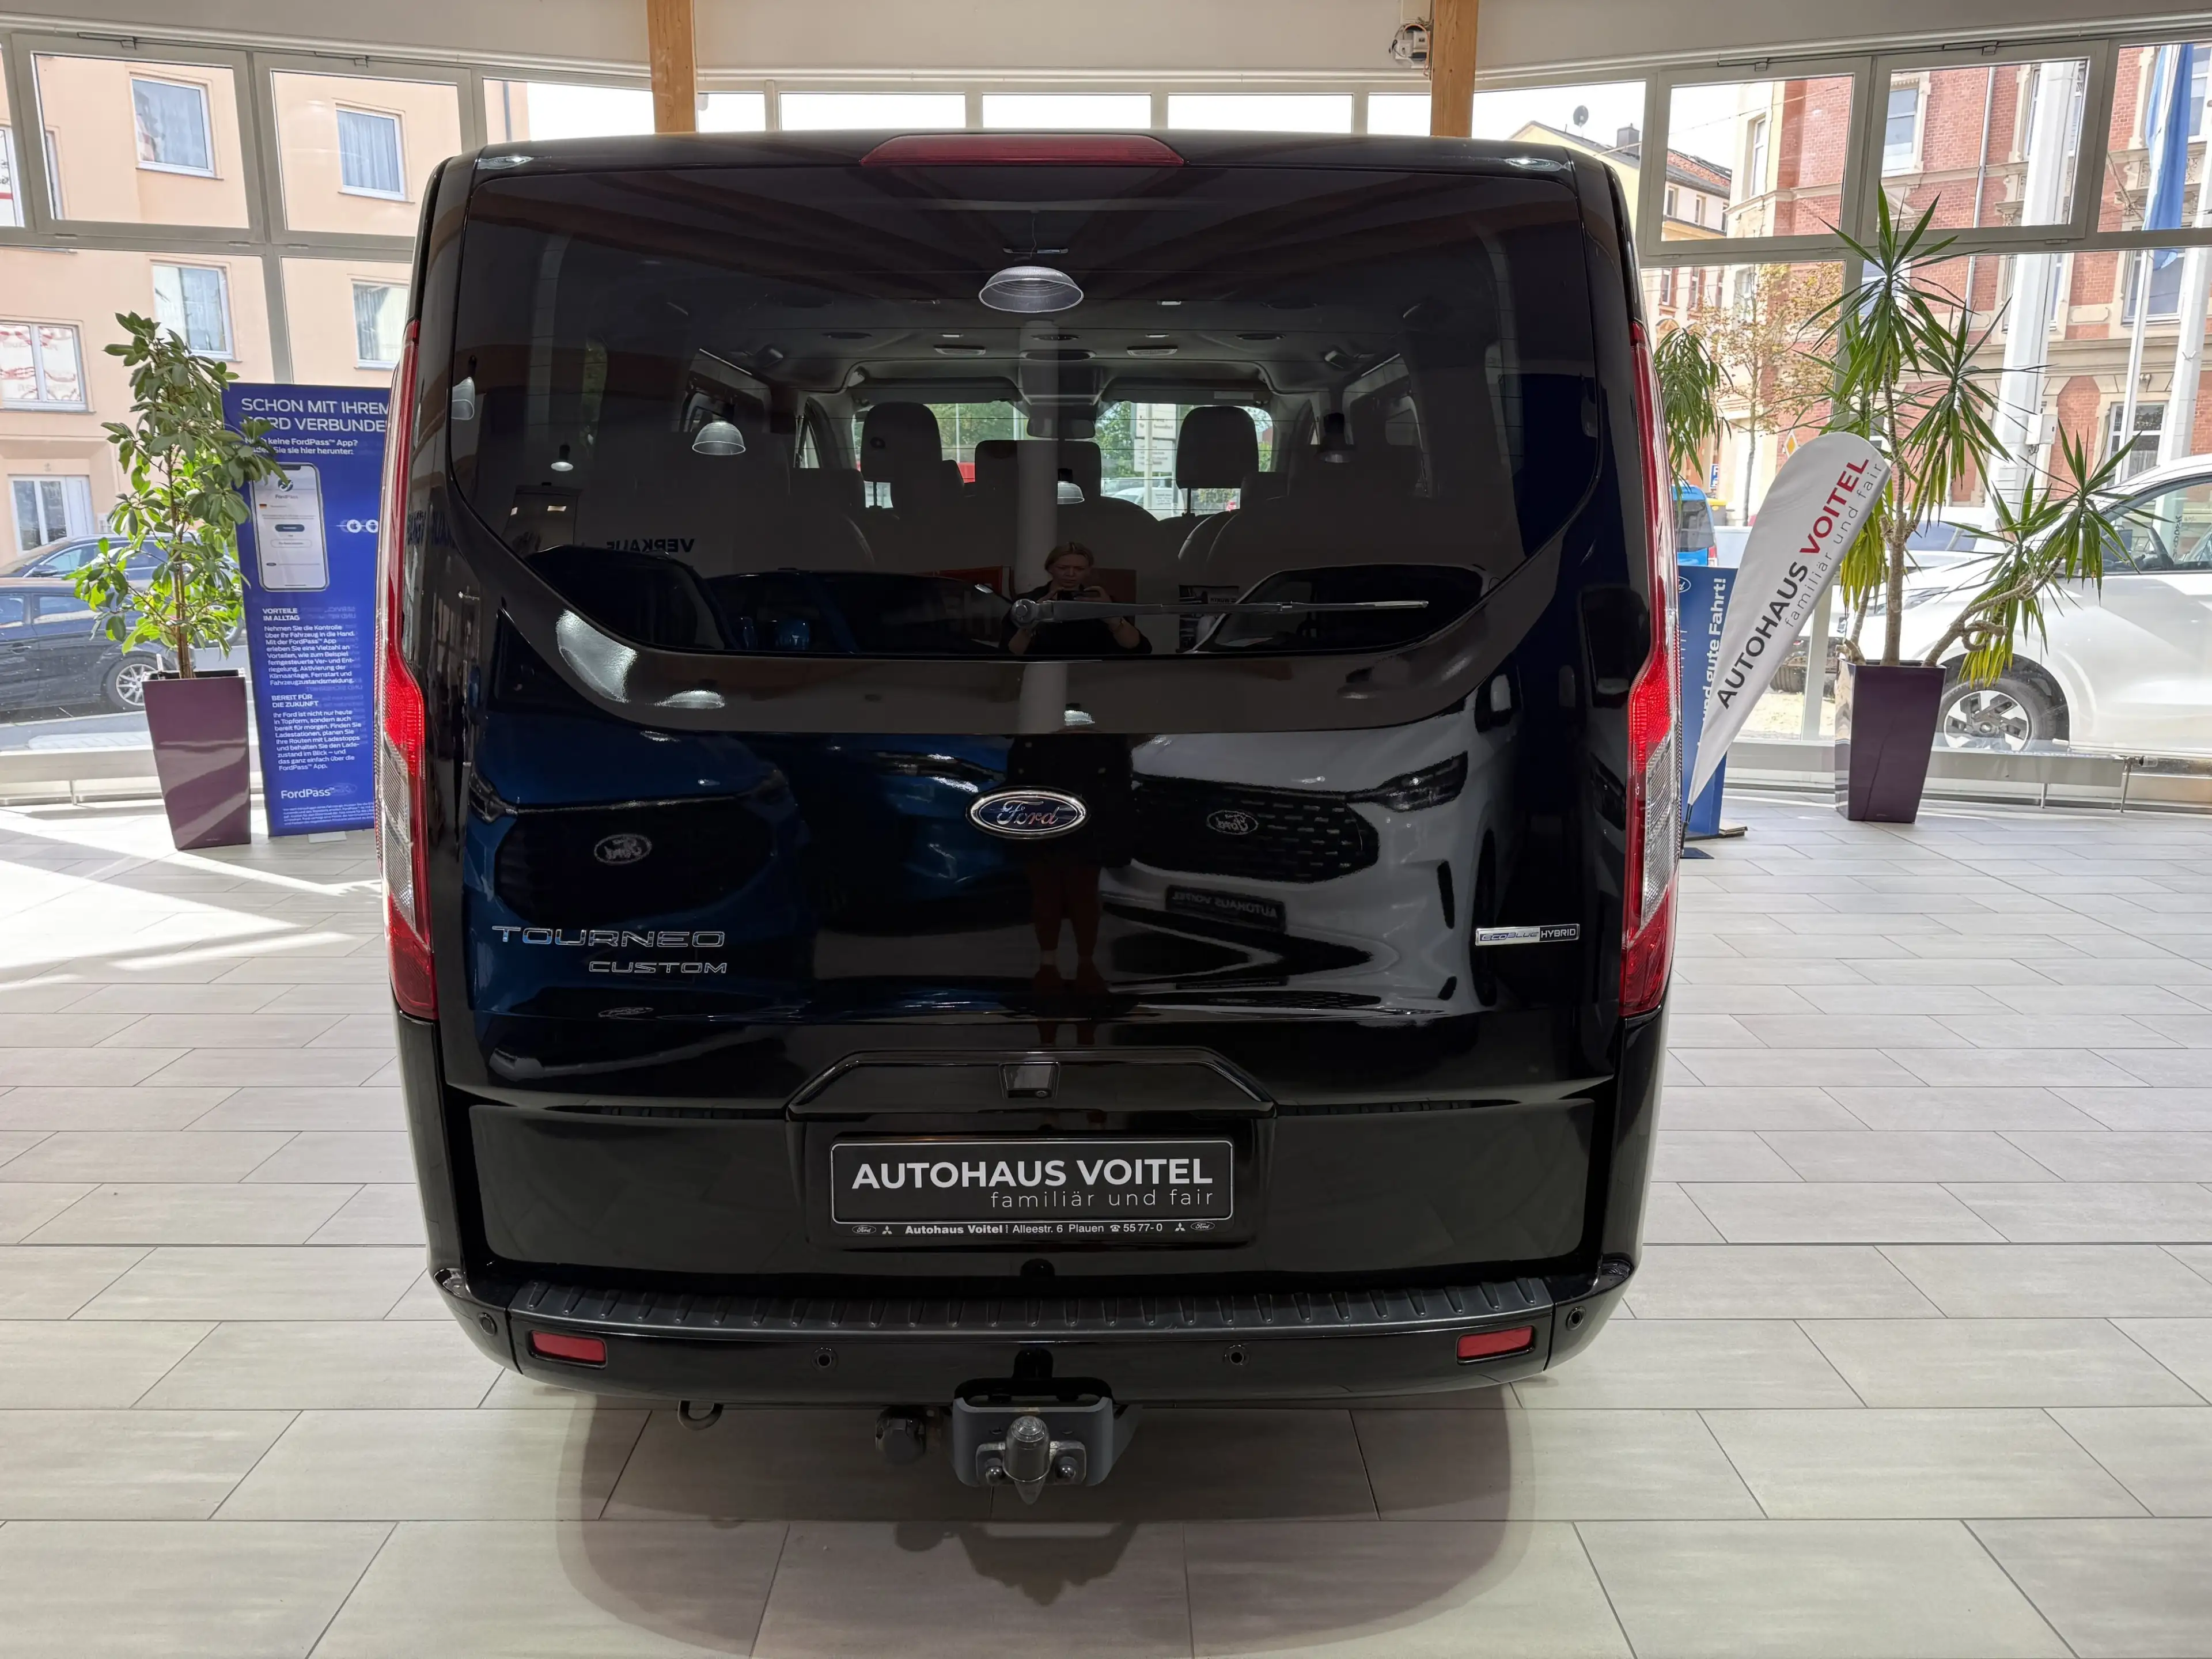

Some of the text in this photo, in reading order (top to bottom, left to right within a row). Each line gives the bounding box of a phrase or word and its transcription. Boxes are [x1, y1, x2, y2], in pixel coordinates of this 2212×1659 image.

[241, 398, 304, 412] SCHON
[308, 400, 337, 414] MIT
[294, 418, 387, 432] VERBUNDE
[1785, 463, 1882, 627] familiär und fair
[1717, 459, 1869, 709] AUTOHAUS VOITEL
[1708, 578, 1726, 635] Fahrt!
[270, 678, 355, 686] Fahrzeugzustandsmeldung.
[492, 925, 725, 948] TOURNEO
[1541, 928, 1576, 938] HYBRID
[589, 961, 728, 974] CUSTOM
[851, 1158, 1214, 1190] AUTOHAUS VOITEL
[991, 1188, 1214, 1208] familiär und fair
[905, 1225, 964, 1234] Autohaus
[967, 1225, 1003, 1234] Voitel
[1012, 1224, 1054, 1233] Alleestr.
[1056, 1224, 1063, 1233] 6
[1069, 1224, 1104, 1233] Plauen
